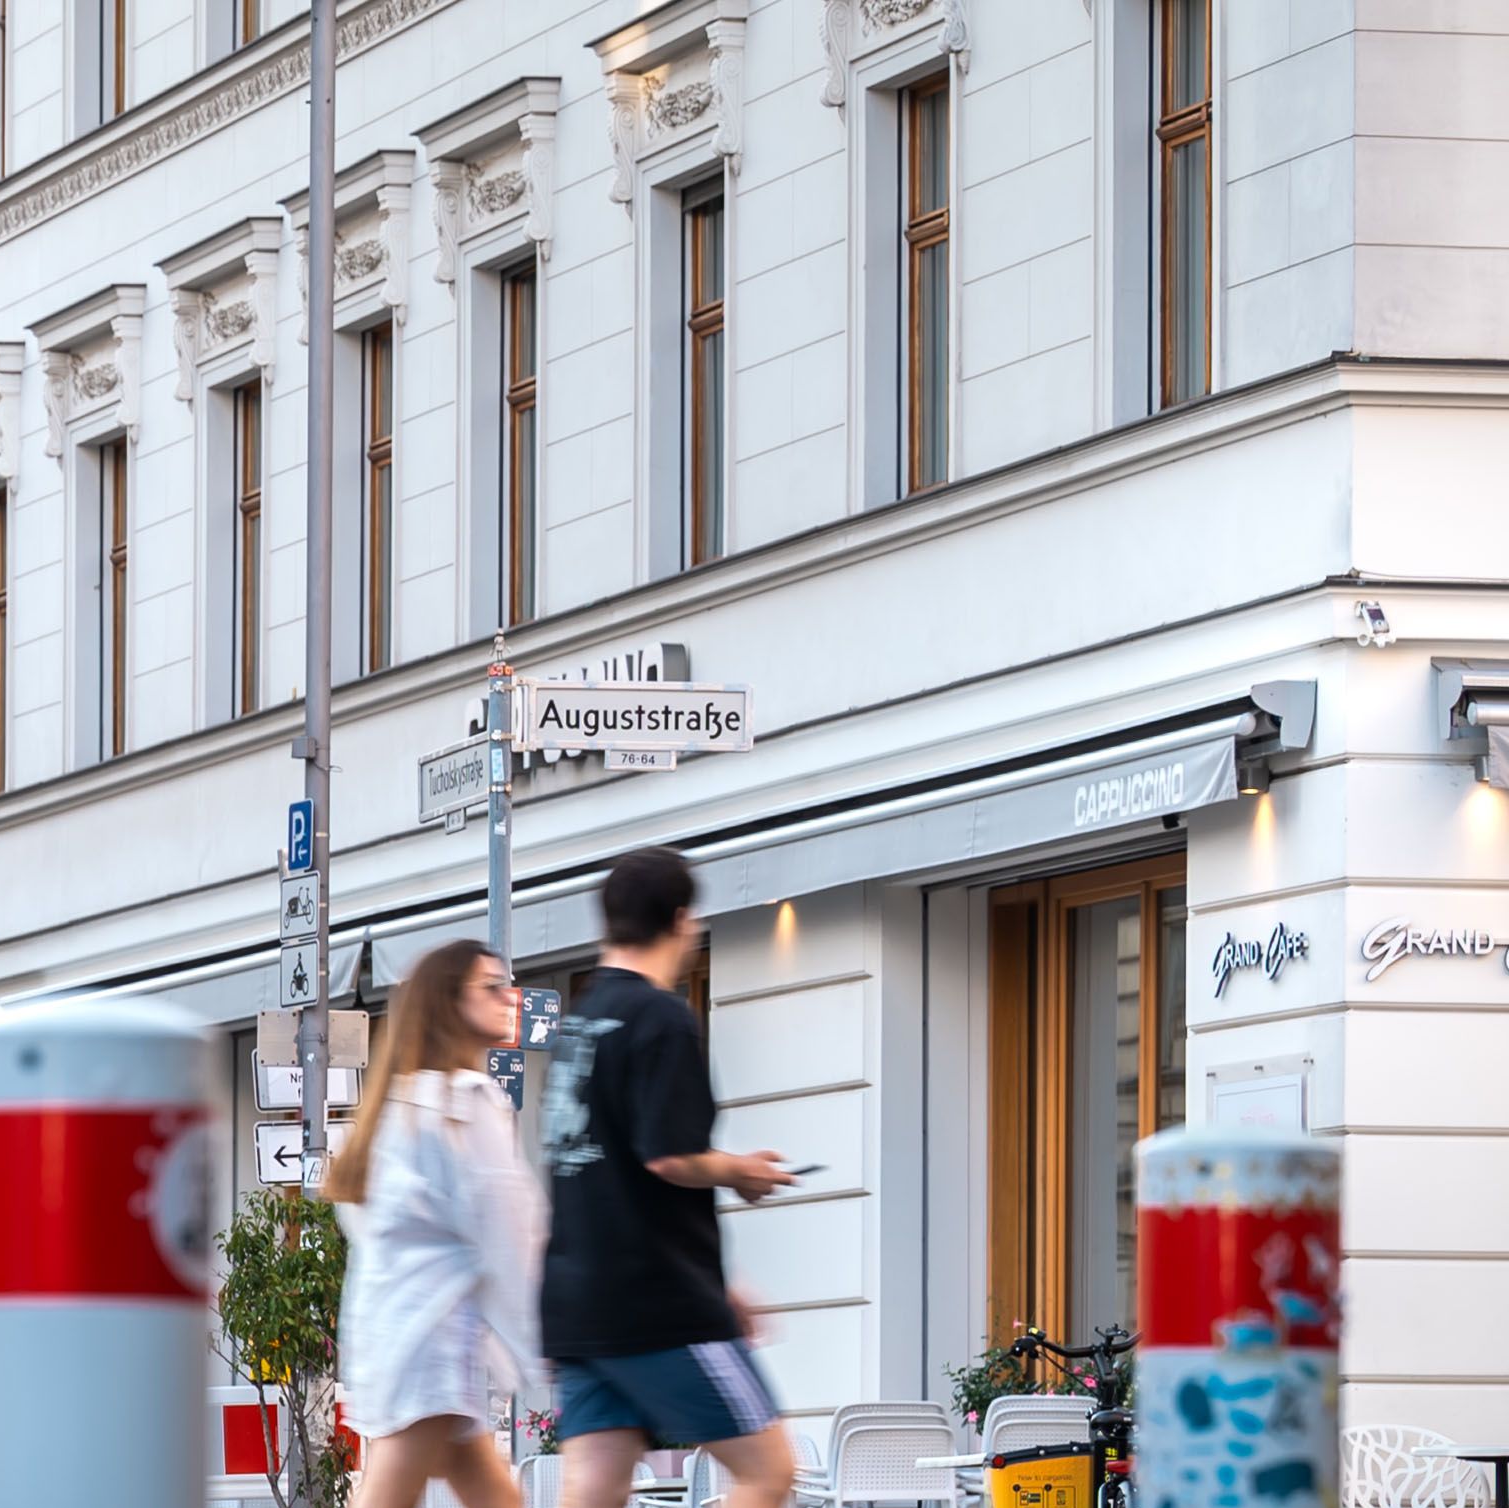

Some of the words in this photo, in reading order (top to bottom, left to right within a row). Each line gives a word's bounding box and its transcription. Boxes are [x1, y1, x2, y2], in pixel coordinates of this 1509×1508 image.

[539, 699, 741, 739] Auguststraße
[428, 751, 484, 798] Tucholskystraße
[621, 753, 656, 765] 76-64
[1074, 762, 1184, 827] CAPPUCCINO
[1362, 914, 1495, 983] GRAND
[523, 997, 533, 1012] S
[544, 1003, 558, 1014] 100
[490, 1057, 499, 1072] S
[510, 1063, 524, 1073] 100
